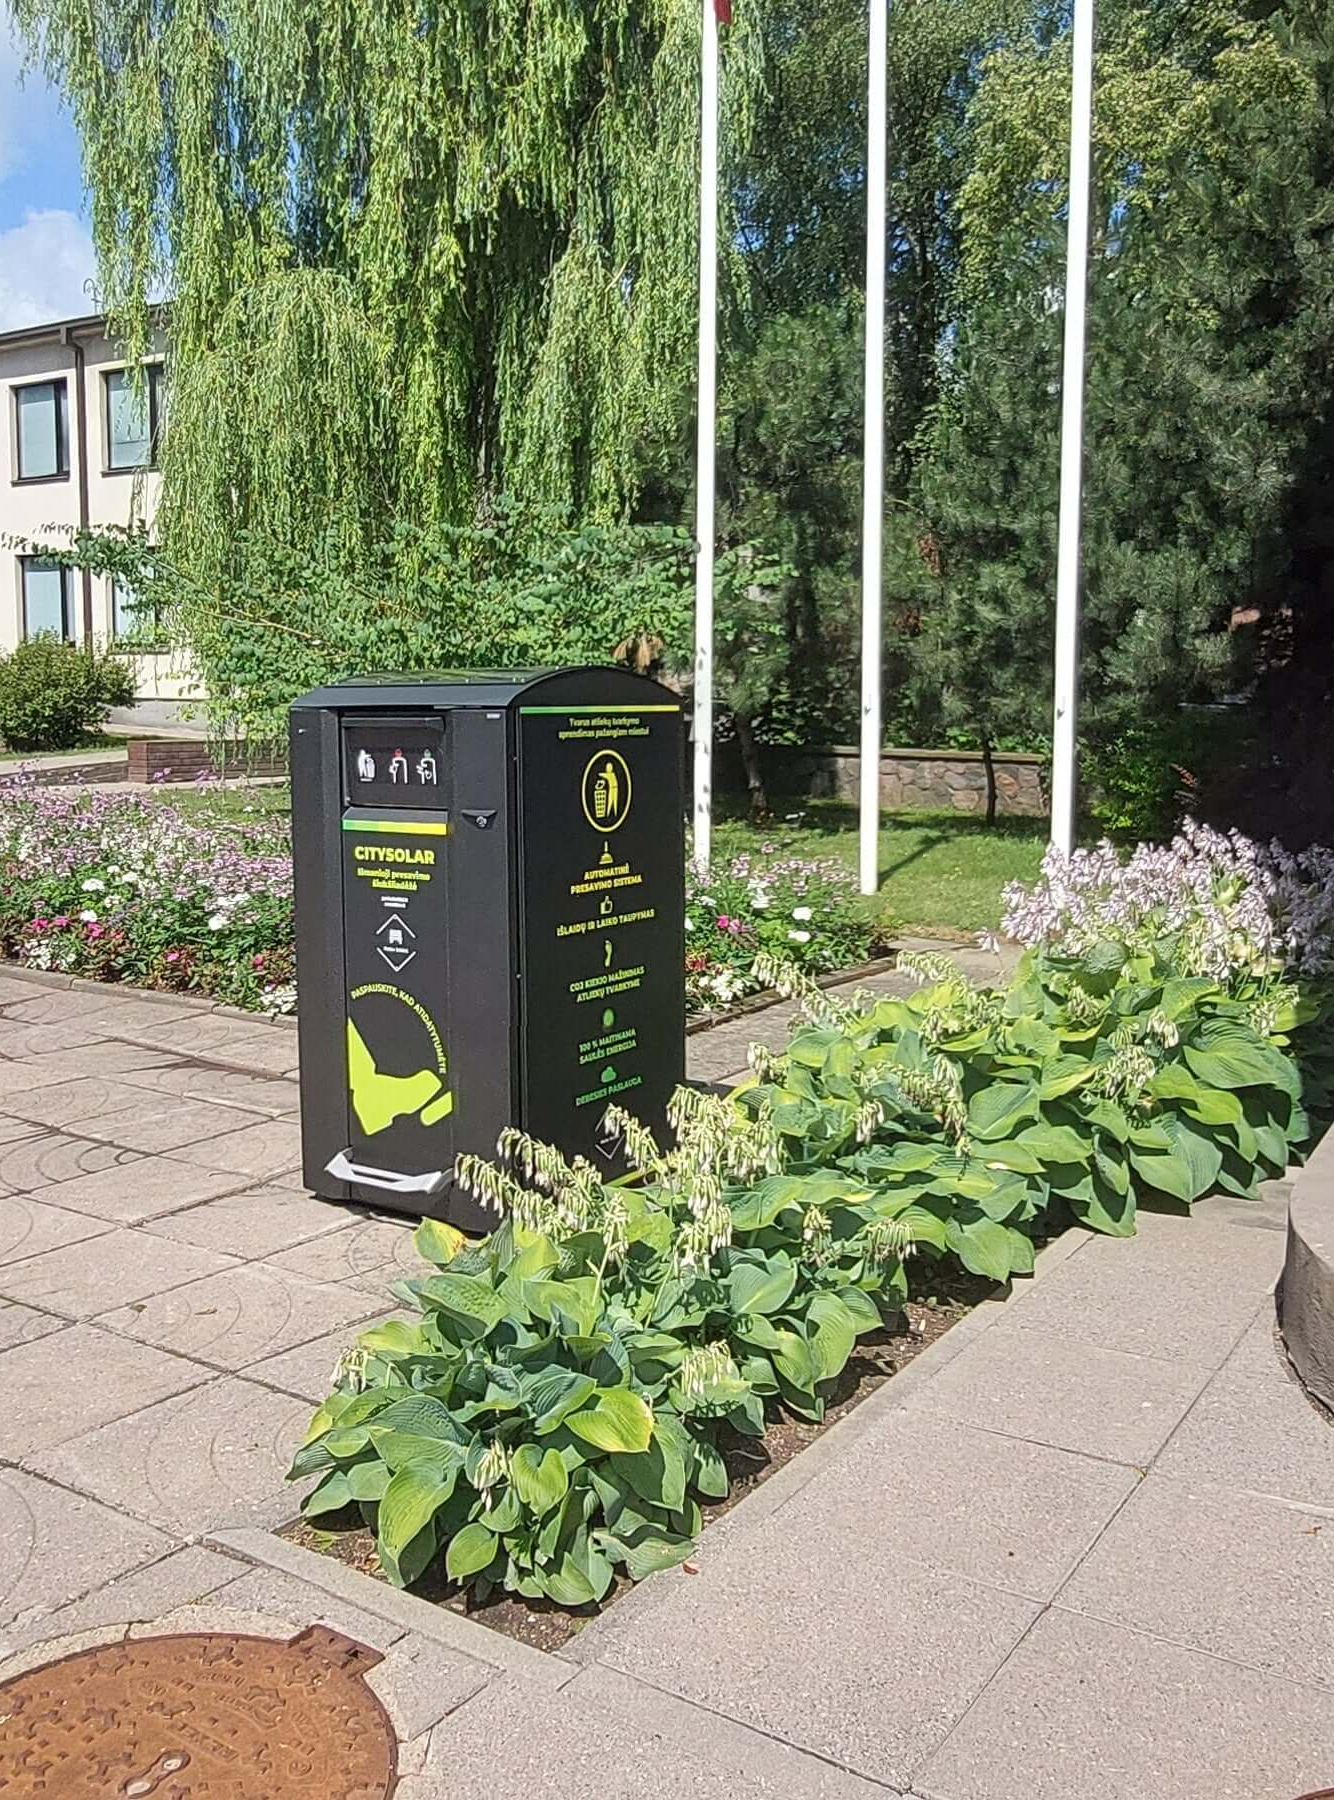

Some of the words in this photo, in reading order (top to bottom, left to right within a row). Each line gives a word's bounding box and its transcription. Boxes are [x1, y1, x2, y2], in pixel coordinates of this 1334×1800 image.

[354, 845, 436, 865] CITYSOLAR
[570, 879, 613, 895] PRESAVIMO
[613, 873, 643, 888] SISTEMA
[587, 920, 596, 930] IR
[596, 916, 619, 929] LAIKO
[618, 908, 655, 924] TAUPYMAS
[399, 990, 416, 1007] KAD
[578, 1041, 591, 1053] 100
